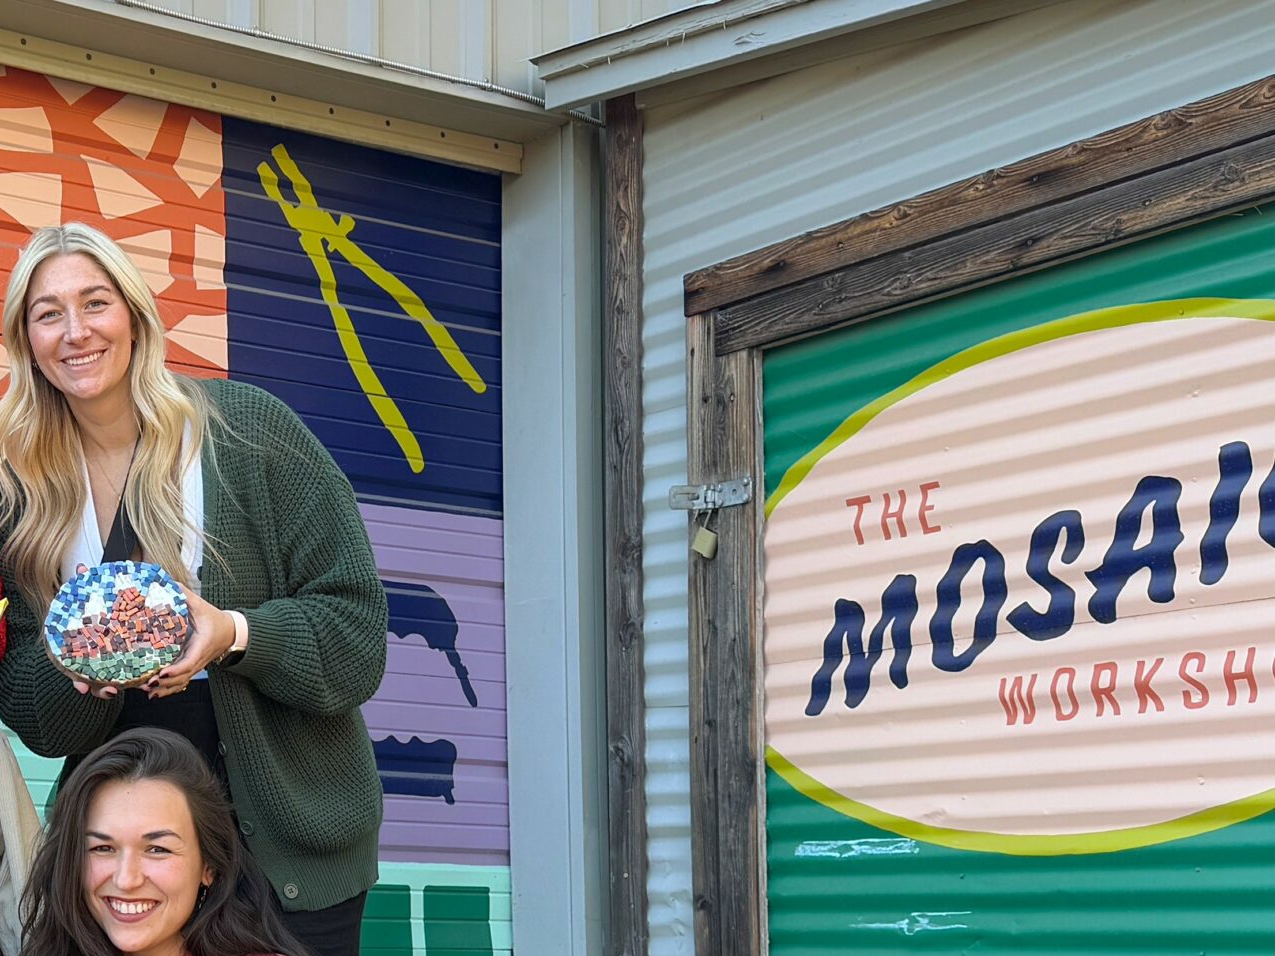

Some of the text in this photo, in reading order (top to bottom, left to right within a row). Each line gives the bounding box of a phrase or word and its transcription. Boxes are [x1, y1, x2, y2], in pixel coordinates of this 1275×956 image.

[846, 481, 942, 545] THE
[804, 440, 1275, 717] MOSAI
[998, 646, 1275, 726] WORKSH
